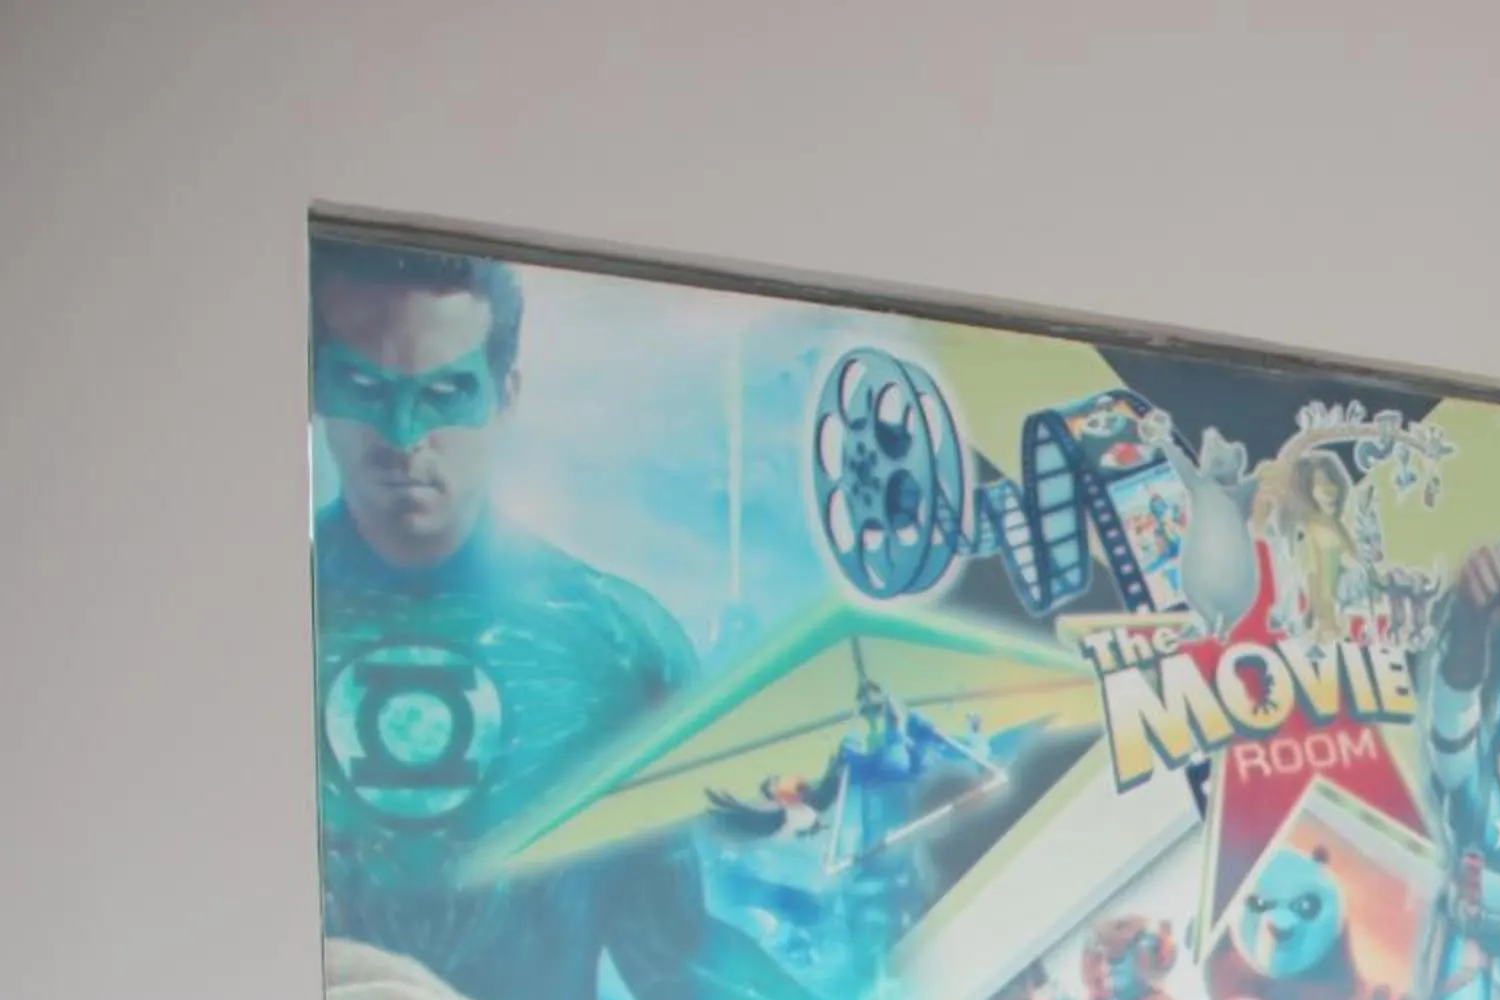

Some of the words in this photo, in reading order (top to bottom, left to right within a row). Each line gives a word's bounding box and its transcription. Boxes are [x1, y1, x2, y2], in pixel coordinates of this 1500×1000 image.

[1083, 627, 1180, 671] The
[1103, 639, 1415, 793] MOVIE
[1234, 728, 1377, 781] ROOM
